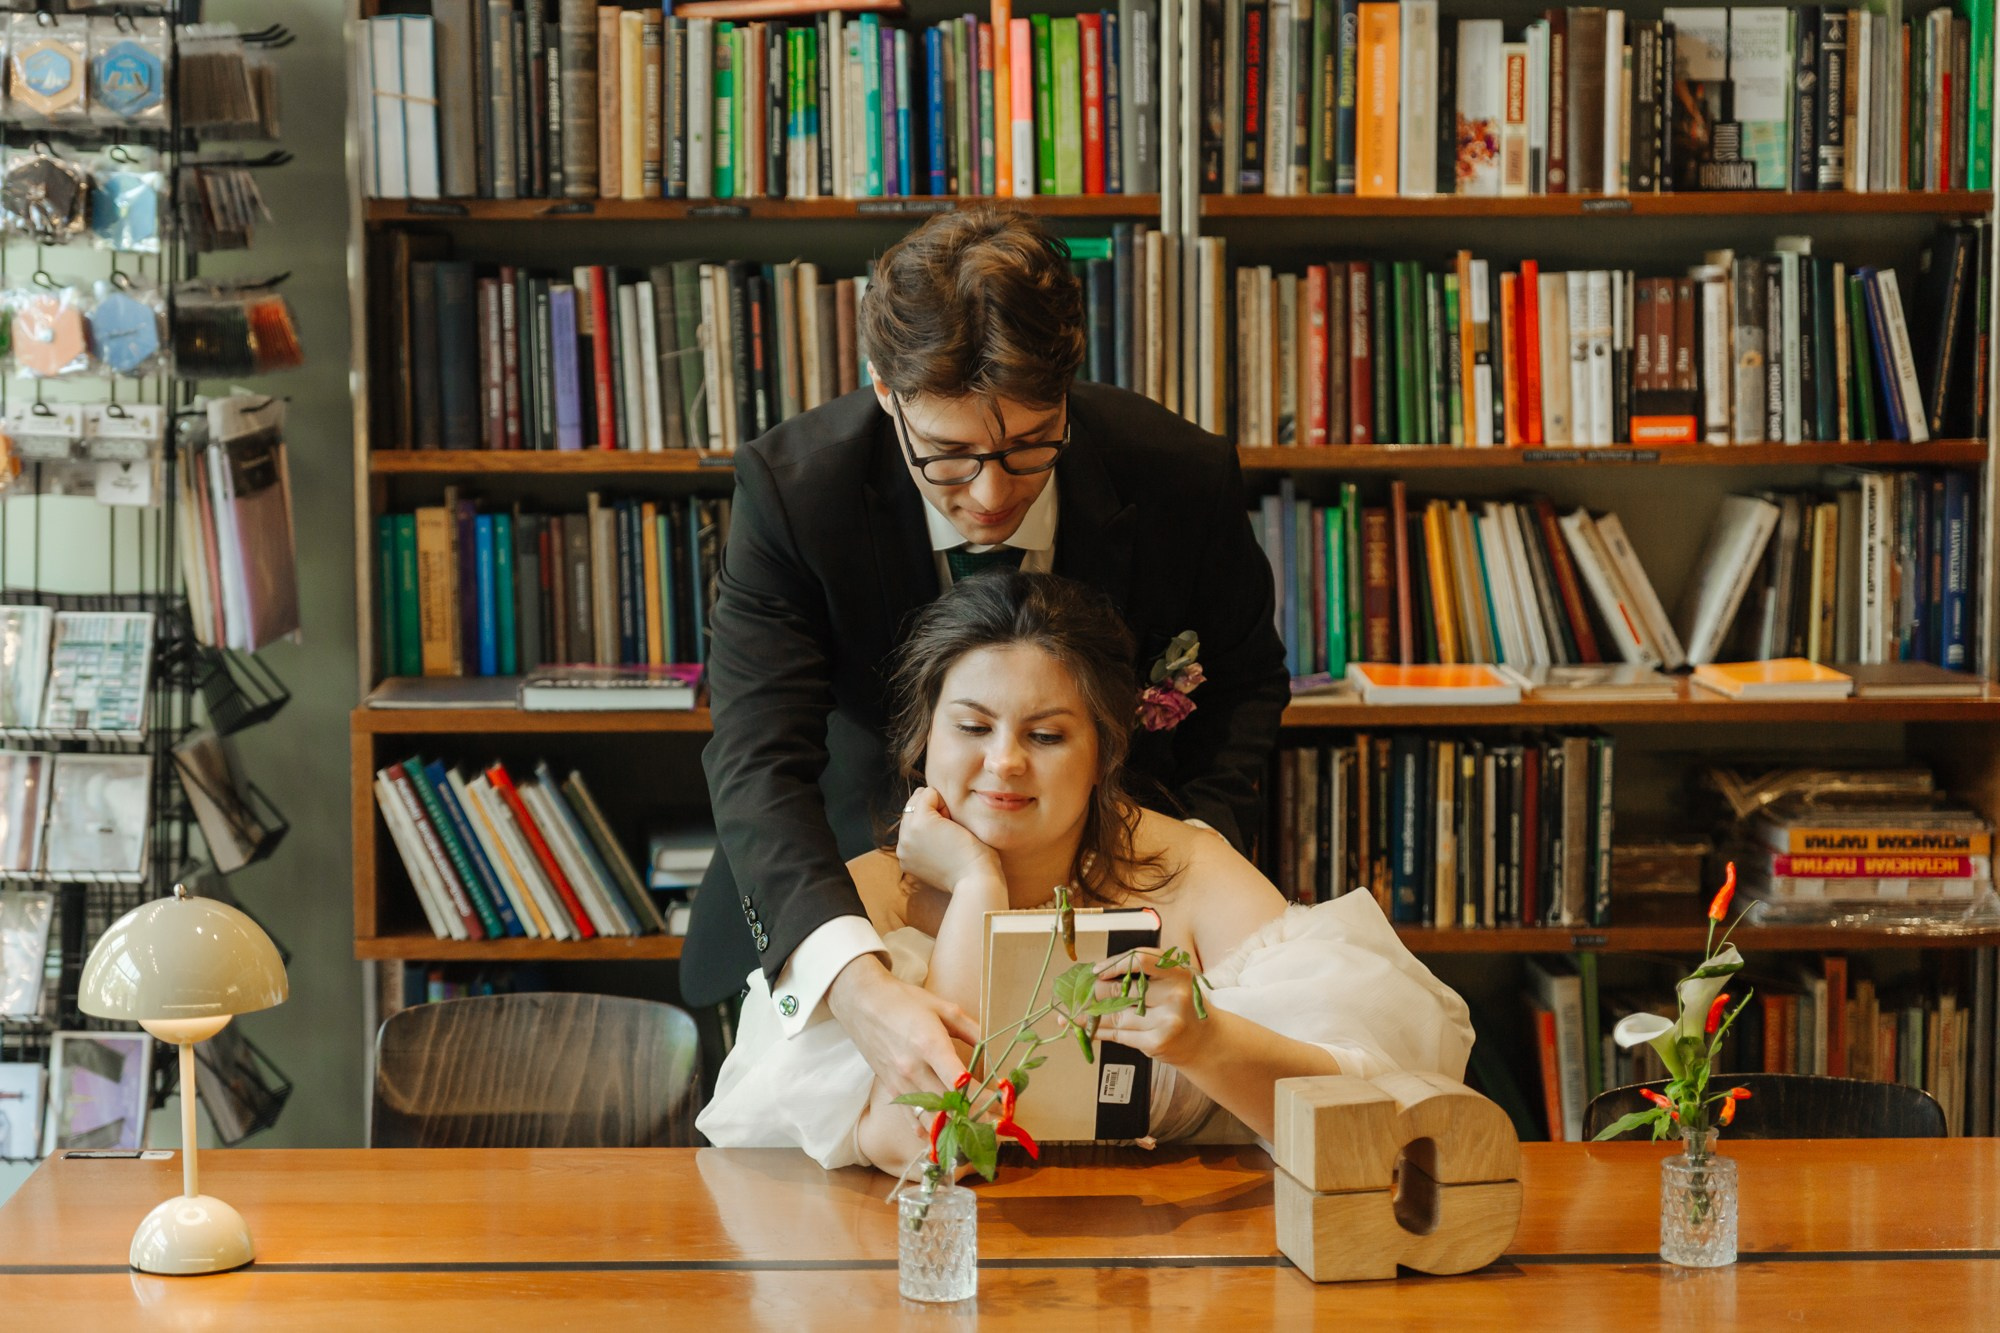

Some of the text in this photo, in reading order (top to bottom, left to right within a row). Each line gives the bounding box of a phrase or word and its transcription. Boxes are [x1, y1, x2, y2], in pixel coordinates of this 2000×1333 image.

[1246, 66, 1259, 134] MARKETING
[1804, 834, 1970, 850] ИСПАНСКАЯ ПАРТИЯ
[1790, 856, 1959, 875] ИСПАНСКАЯ ПАРТИЯ
